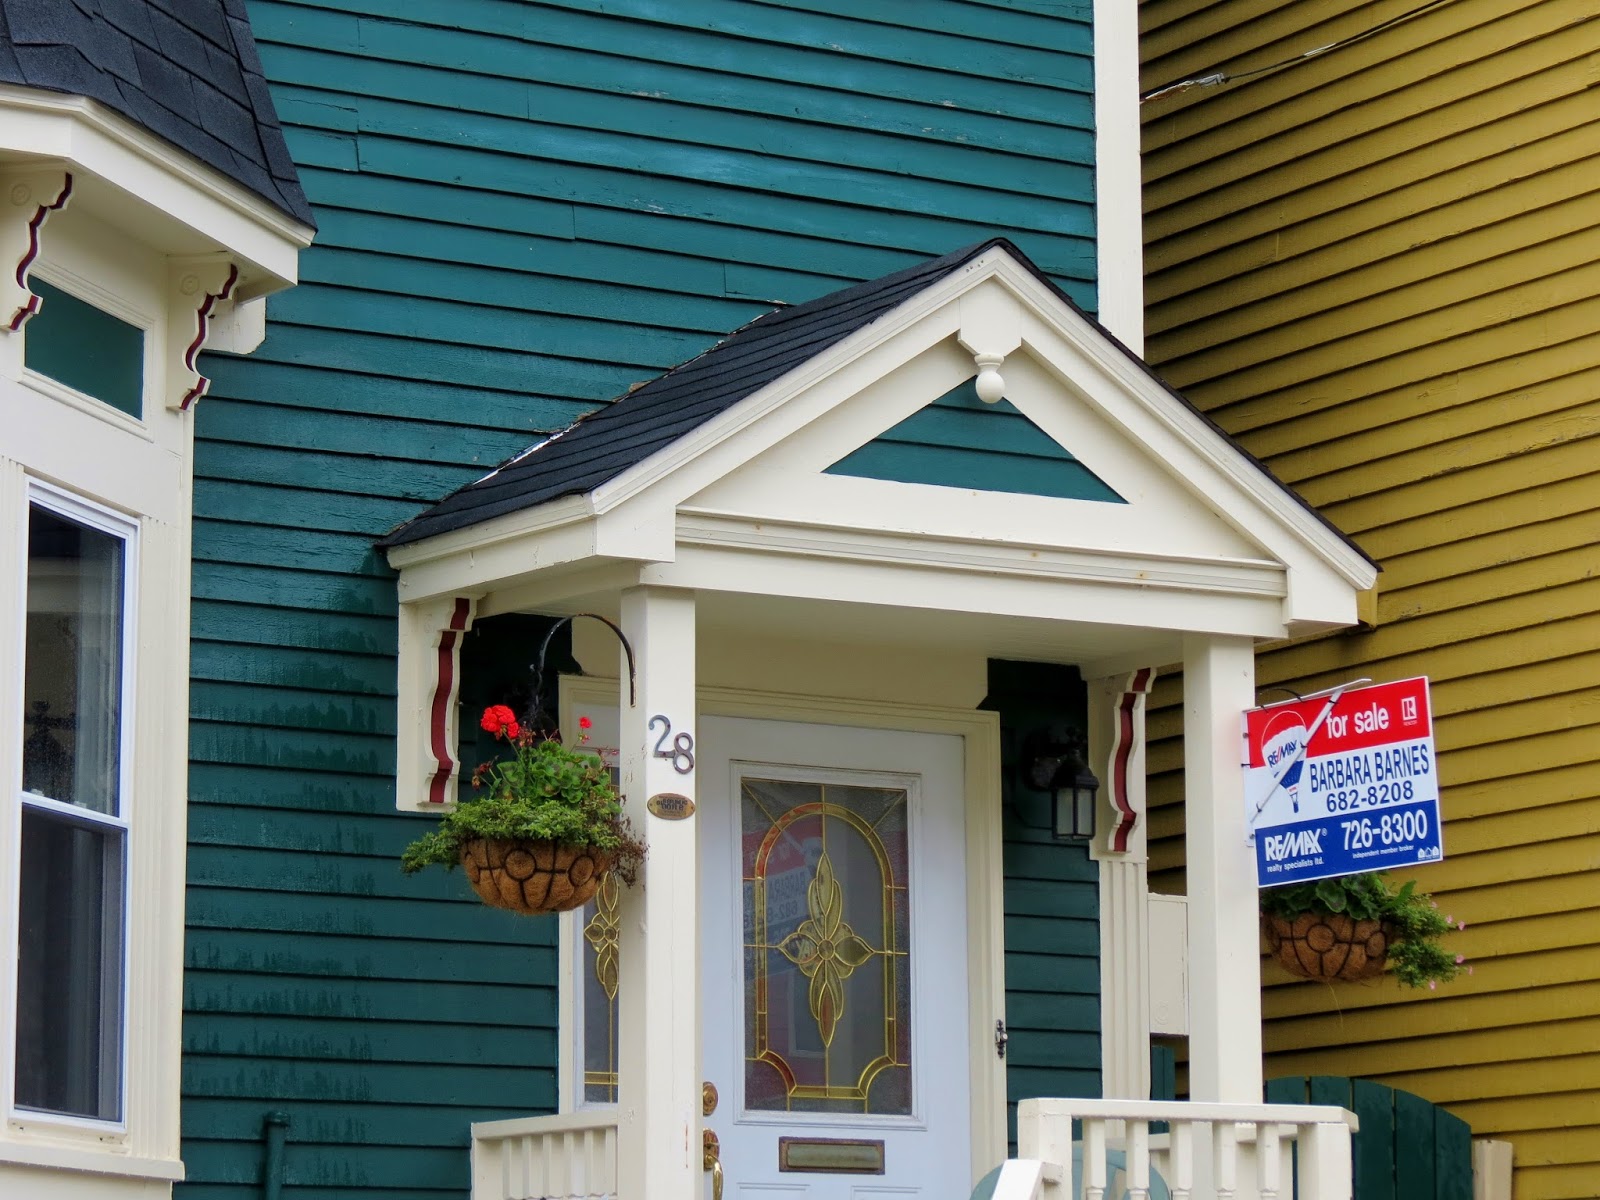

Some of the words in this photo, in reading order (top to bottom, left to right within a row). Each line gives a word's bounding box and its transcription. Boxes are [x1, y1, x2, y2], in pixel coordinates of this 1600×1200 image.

[1326, 711, 1348, 739] for
[1354, 702, 1389, 734] sale
[648, 714, 695, 775] 28
[1309, 757, 1372, 793] BARBARA
[1376, 743, 1430, 782] BARNES
[1326, 780, 1414, 813] 682-8208
[1341, 809, 1428, 850] 726-8300
[1267, 863, 1283, 873] realty
[1284, 859, 1313, 871] specialists
[1380, 846, 1398, 855] member
[1399, 844, 1414, 852] broker
